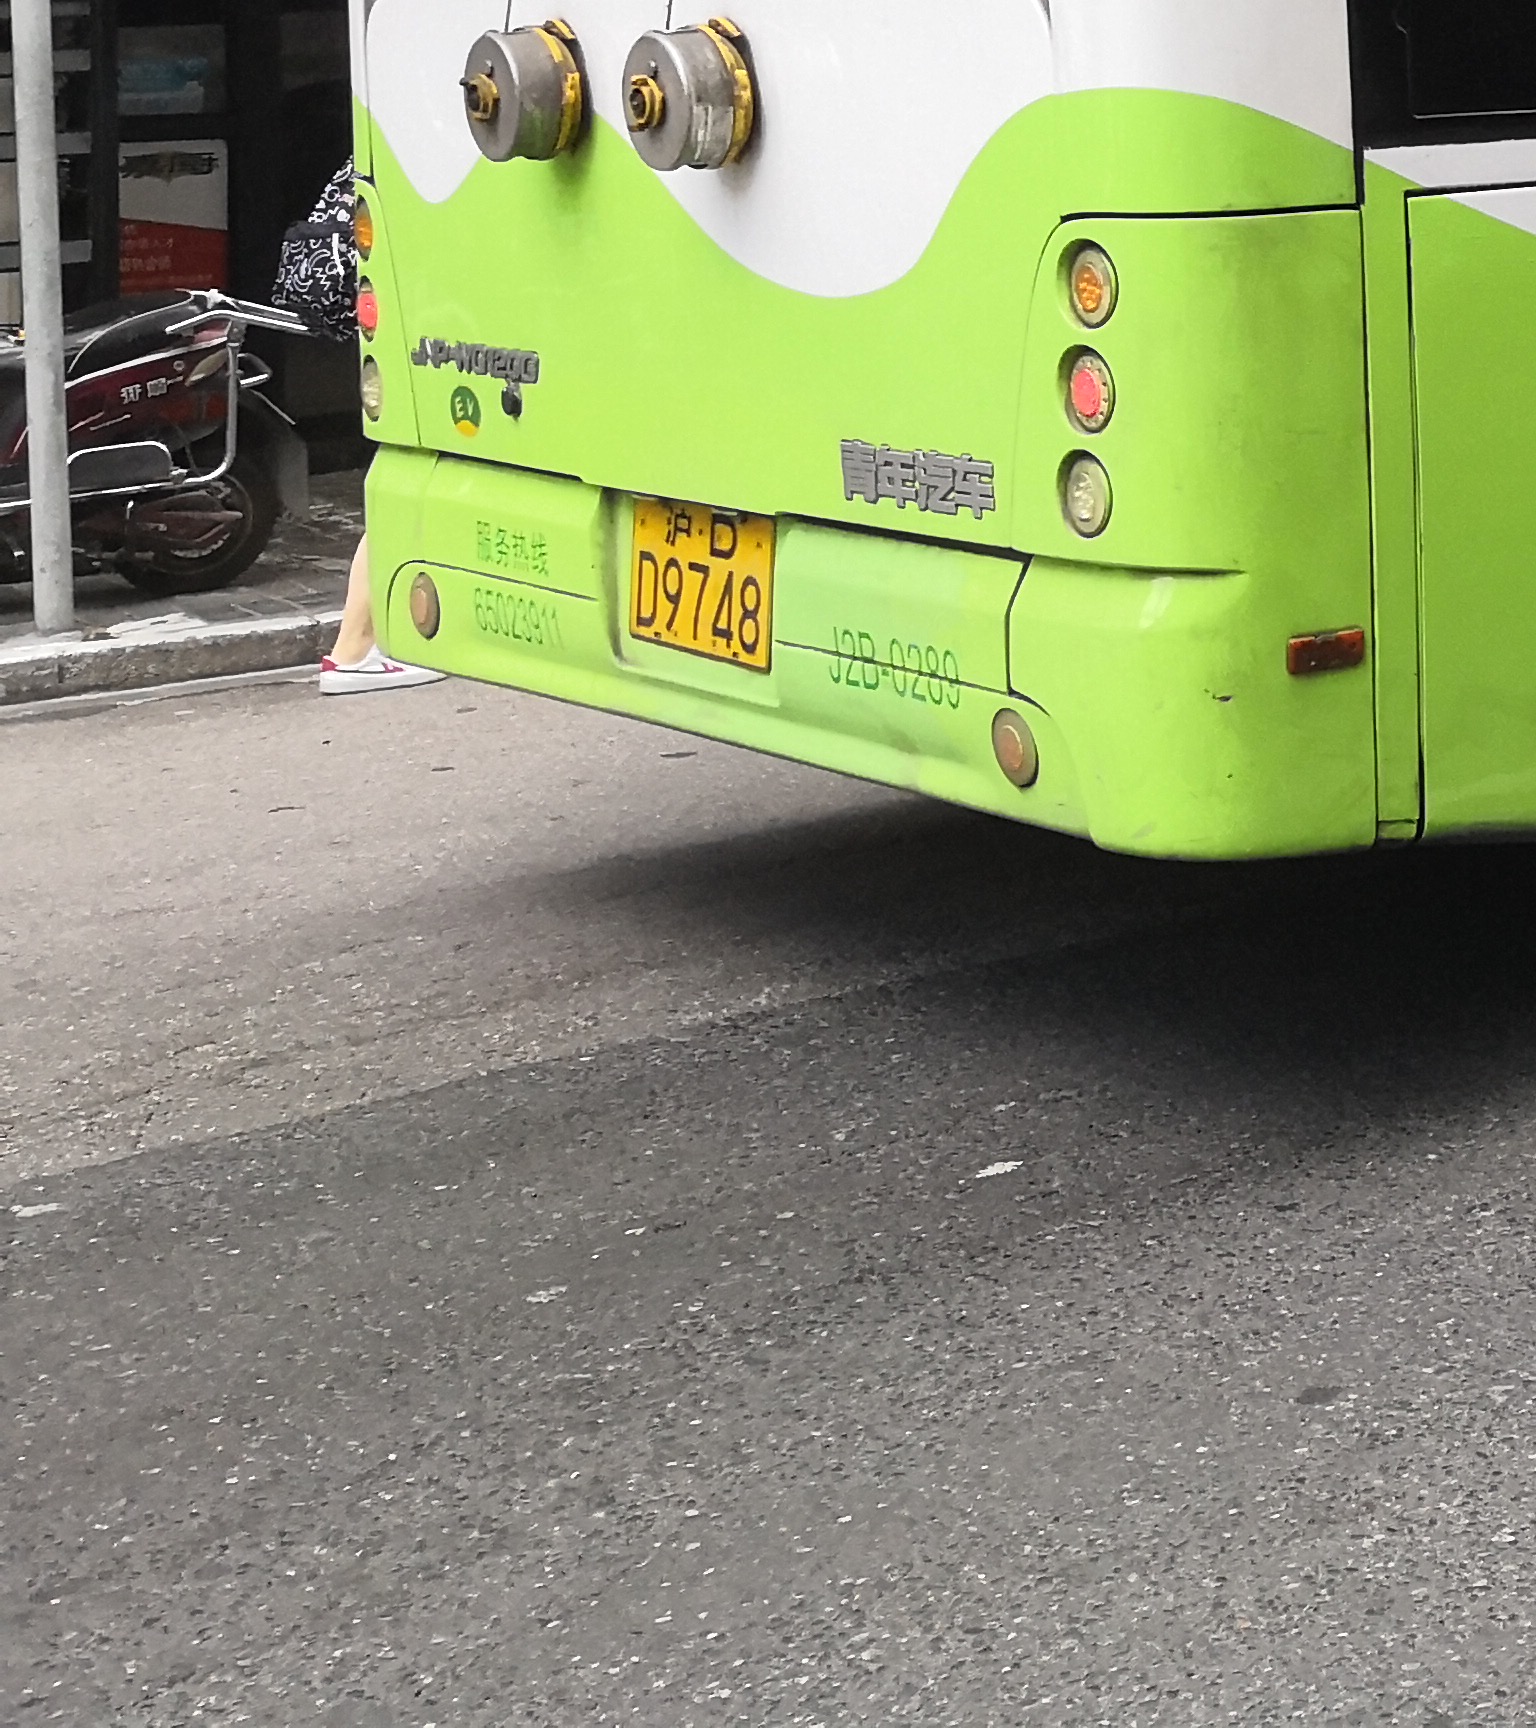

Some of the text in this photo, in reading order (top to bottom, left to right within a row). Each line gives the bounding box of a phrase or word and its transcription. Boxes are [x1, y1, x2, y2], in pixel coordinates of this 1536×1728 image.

[454, 395, 475, 418] EV
[840, 438, 996, 520] 青年汽车
[476, 520, 550, 577] 服务热线
[636, 550, 762, 655] D9748
[829, 626, 961, 710] J2B-0289
